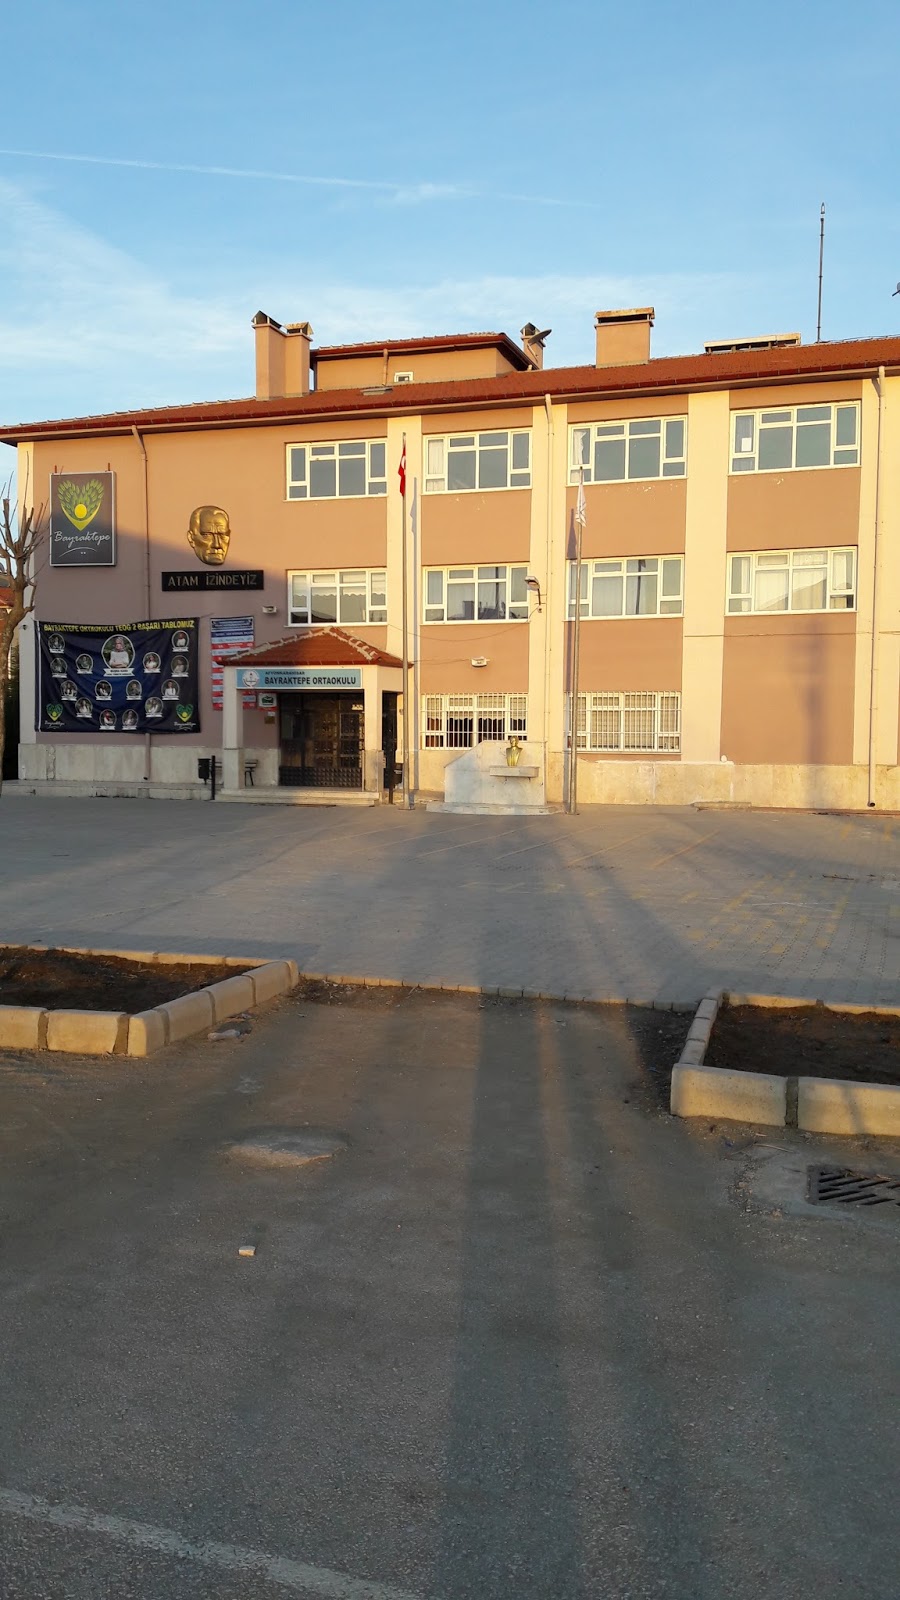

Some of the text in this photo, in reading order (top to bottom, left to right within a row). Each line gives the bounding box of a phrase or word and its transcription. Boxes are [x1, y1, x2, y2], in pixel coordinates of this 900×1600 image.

[54, 531, 111, 548] Bayraktepe
[168, 573, 257, 587] ATAM İZİNDEYİZ
[138, 623, 160, 631] BAŞARI
[161, 620, 194, 629] TABLOMUZ
[265, 677, 356, 685] BAYRAKTEPE ORTAOKULU
